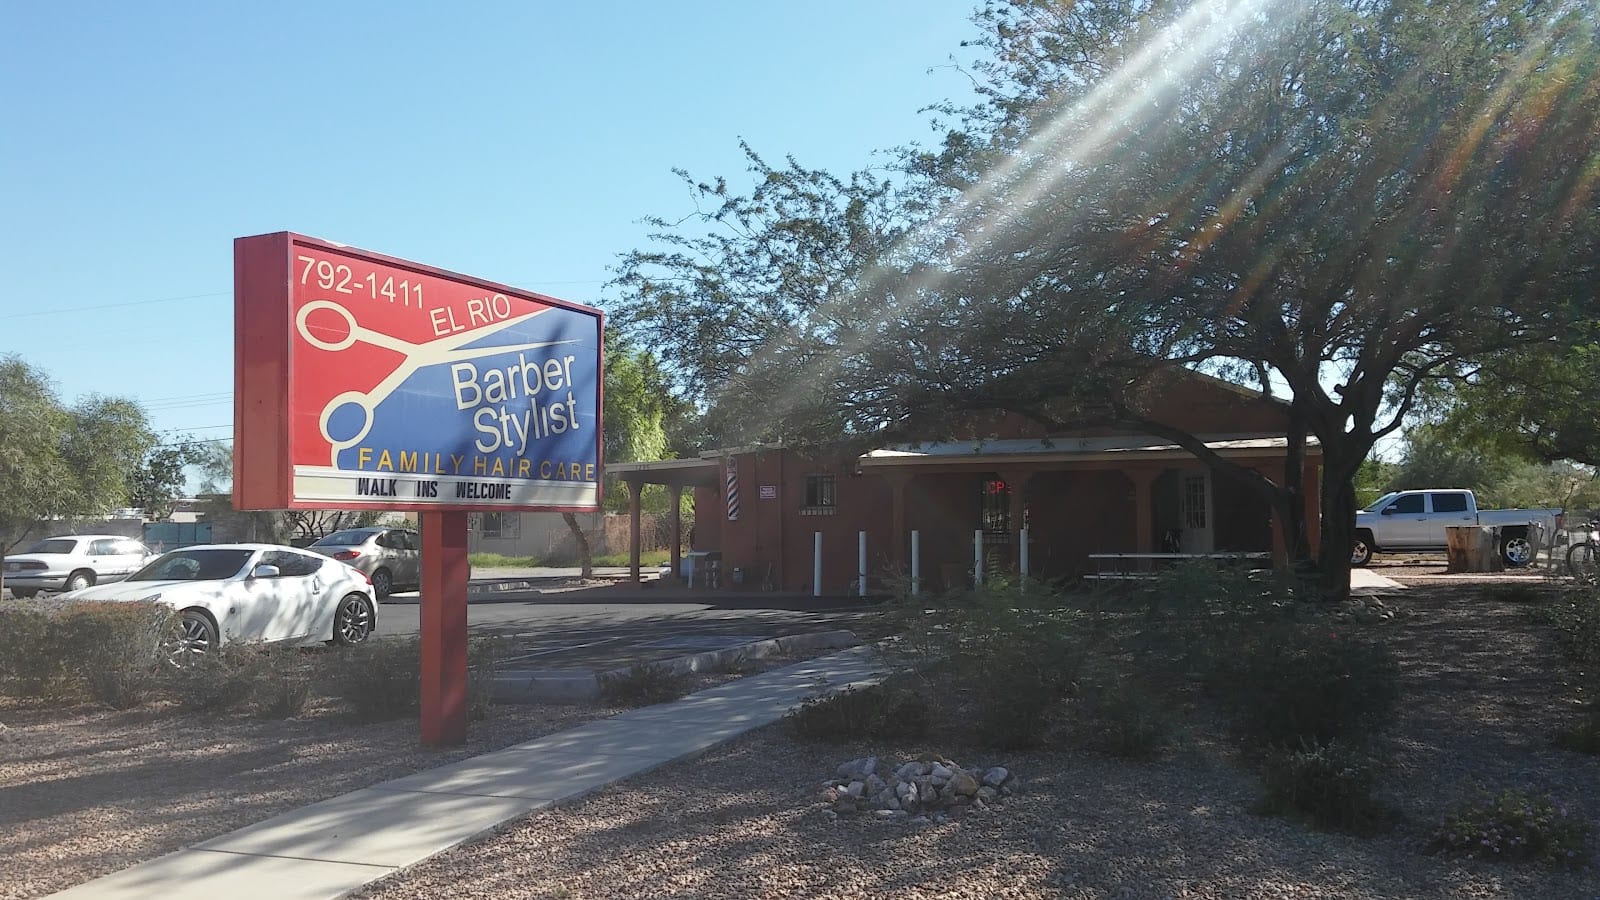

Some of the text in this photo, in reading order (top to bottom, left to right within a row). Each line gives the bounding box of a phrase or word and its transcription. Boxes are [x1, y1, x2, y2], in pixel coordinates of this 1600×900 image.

[297, 255, 423, 309] 792-1411
[429, 293, 511, 337] EL RIO
[451, 353, 575, 411] Barber
[473, 391, 579, 457] Stylist
[357, 477, 512, 500] WALK INS WELCOME
[358, 447, 595, 482] FAMILY HAIR CARE
